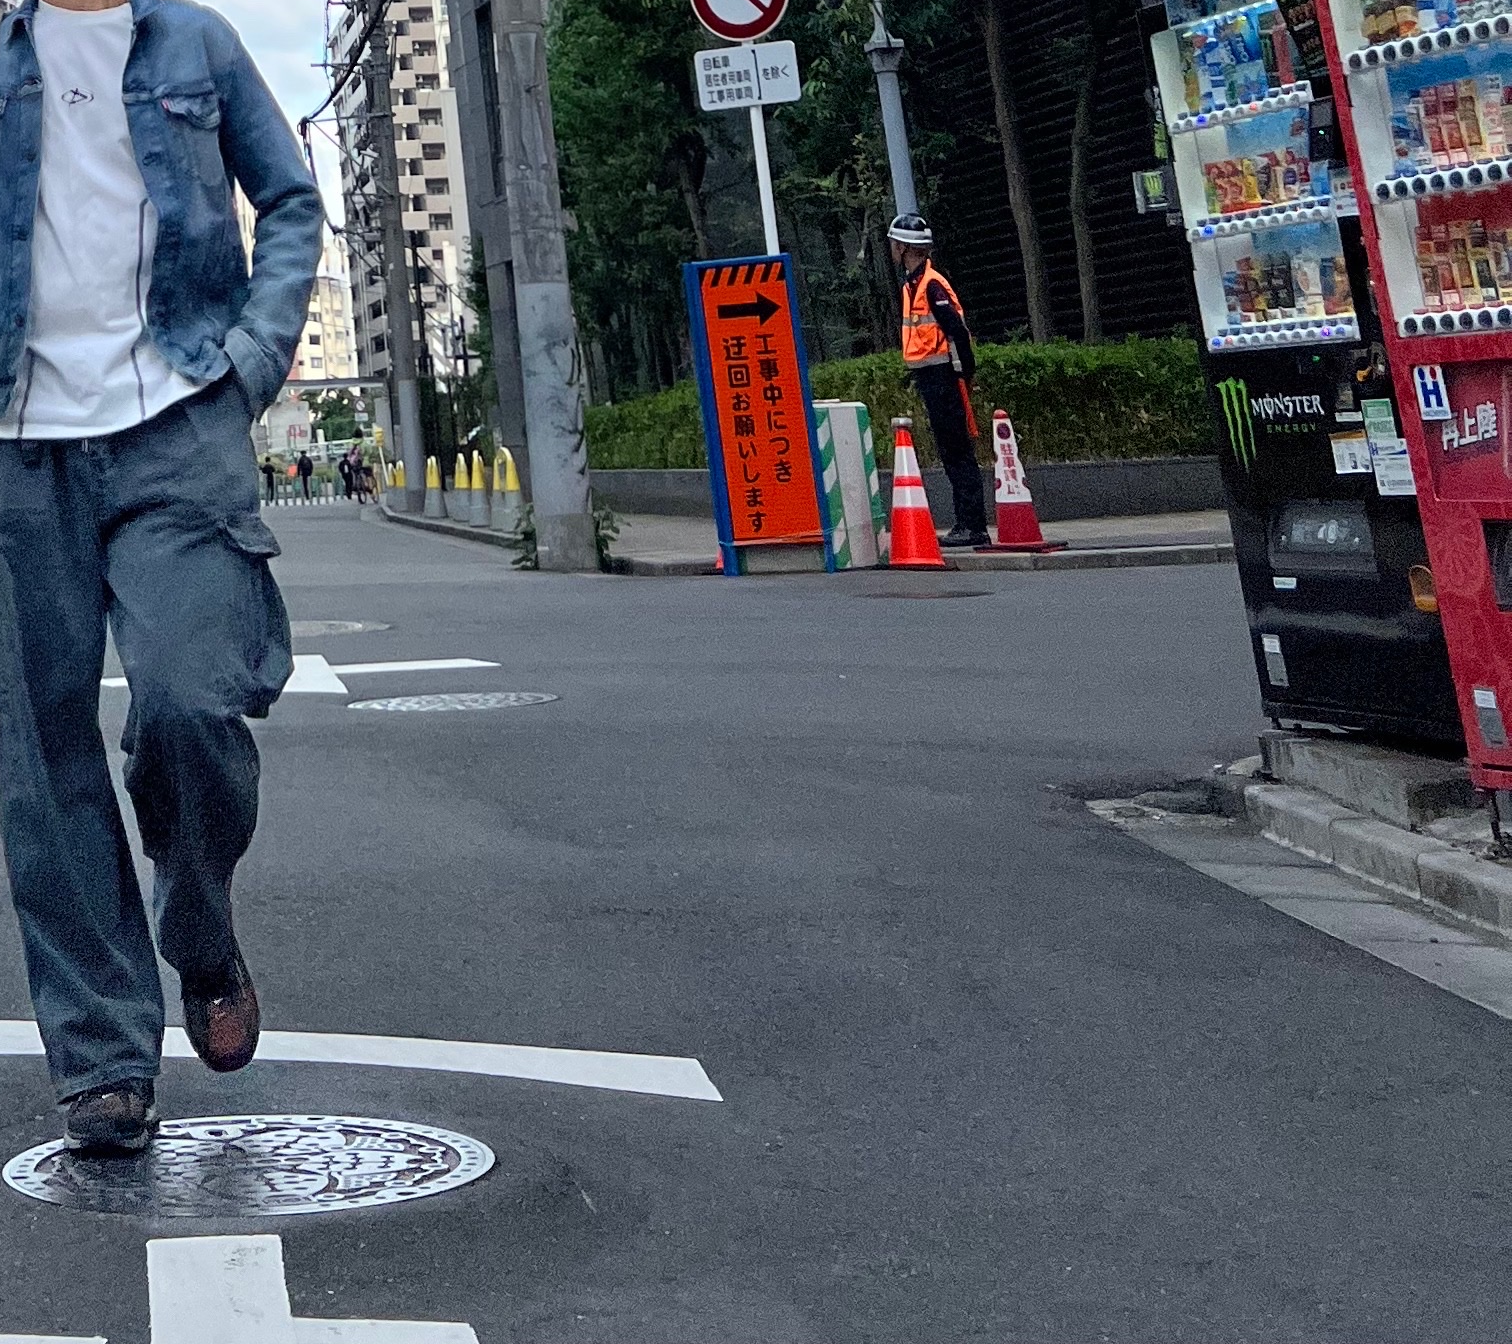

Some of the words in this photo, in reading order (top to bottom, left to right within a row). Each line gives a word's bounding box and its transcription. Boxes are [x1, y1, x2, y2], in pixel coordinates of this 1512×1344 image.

[722, 335, 767, 533] 迂回お願いします
[755, 333, 793, 483] 工事中につき
[1250, 392, 1325, 419] MONSTER
[1266, 422, 1317, 434] ENERGY
